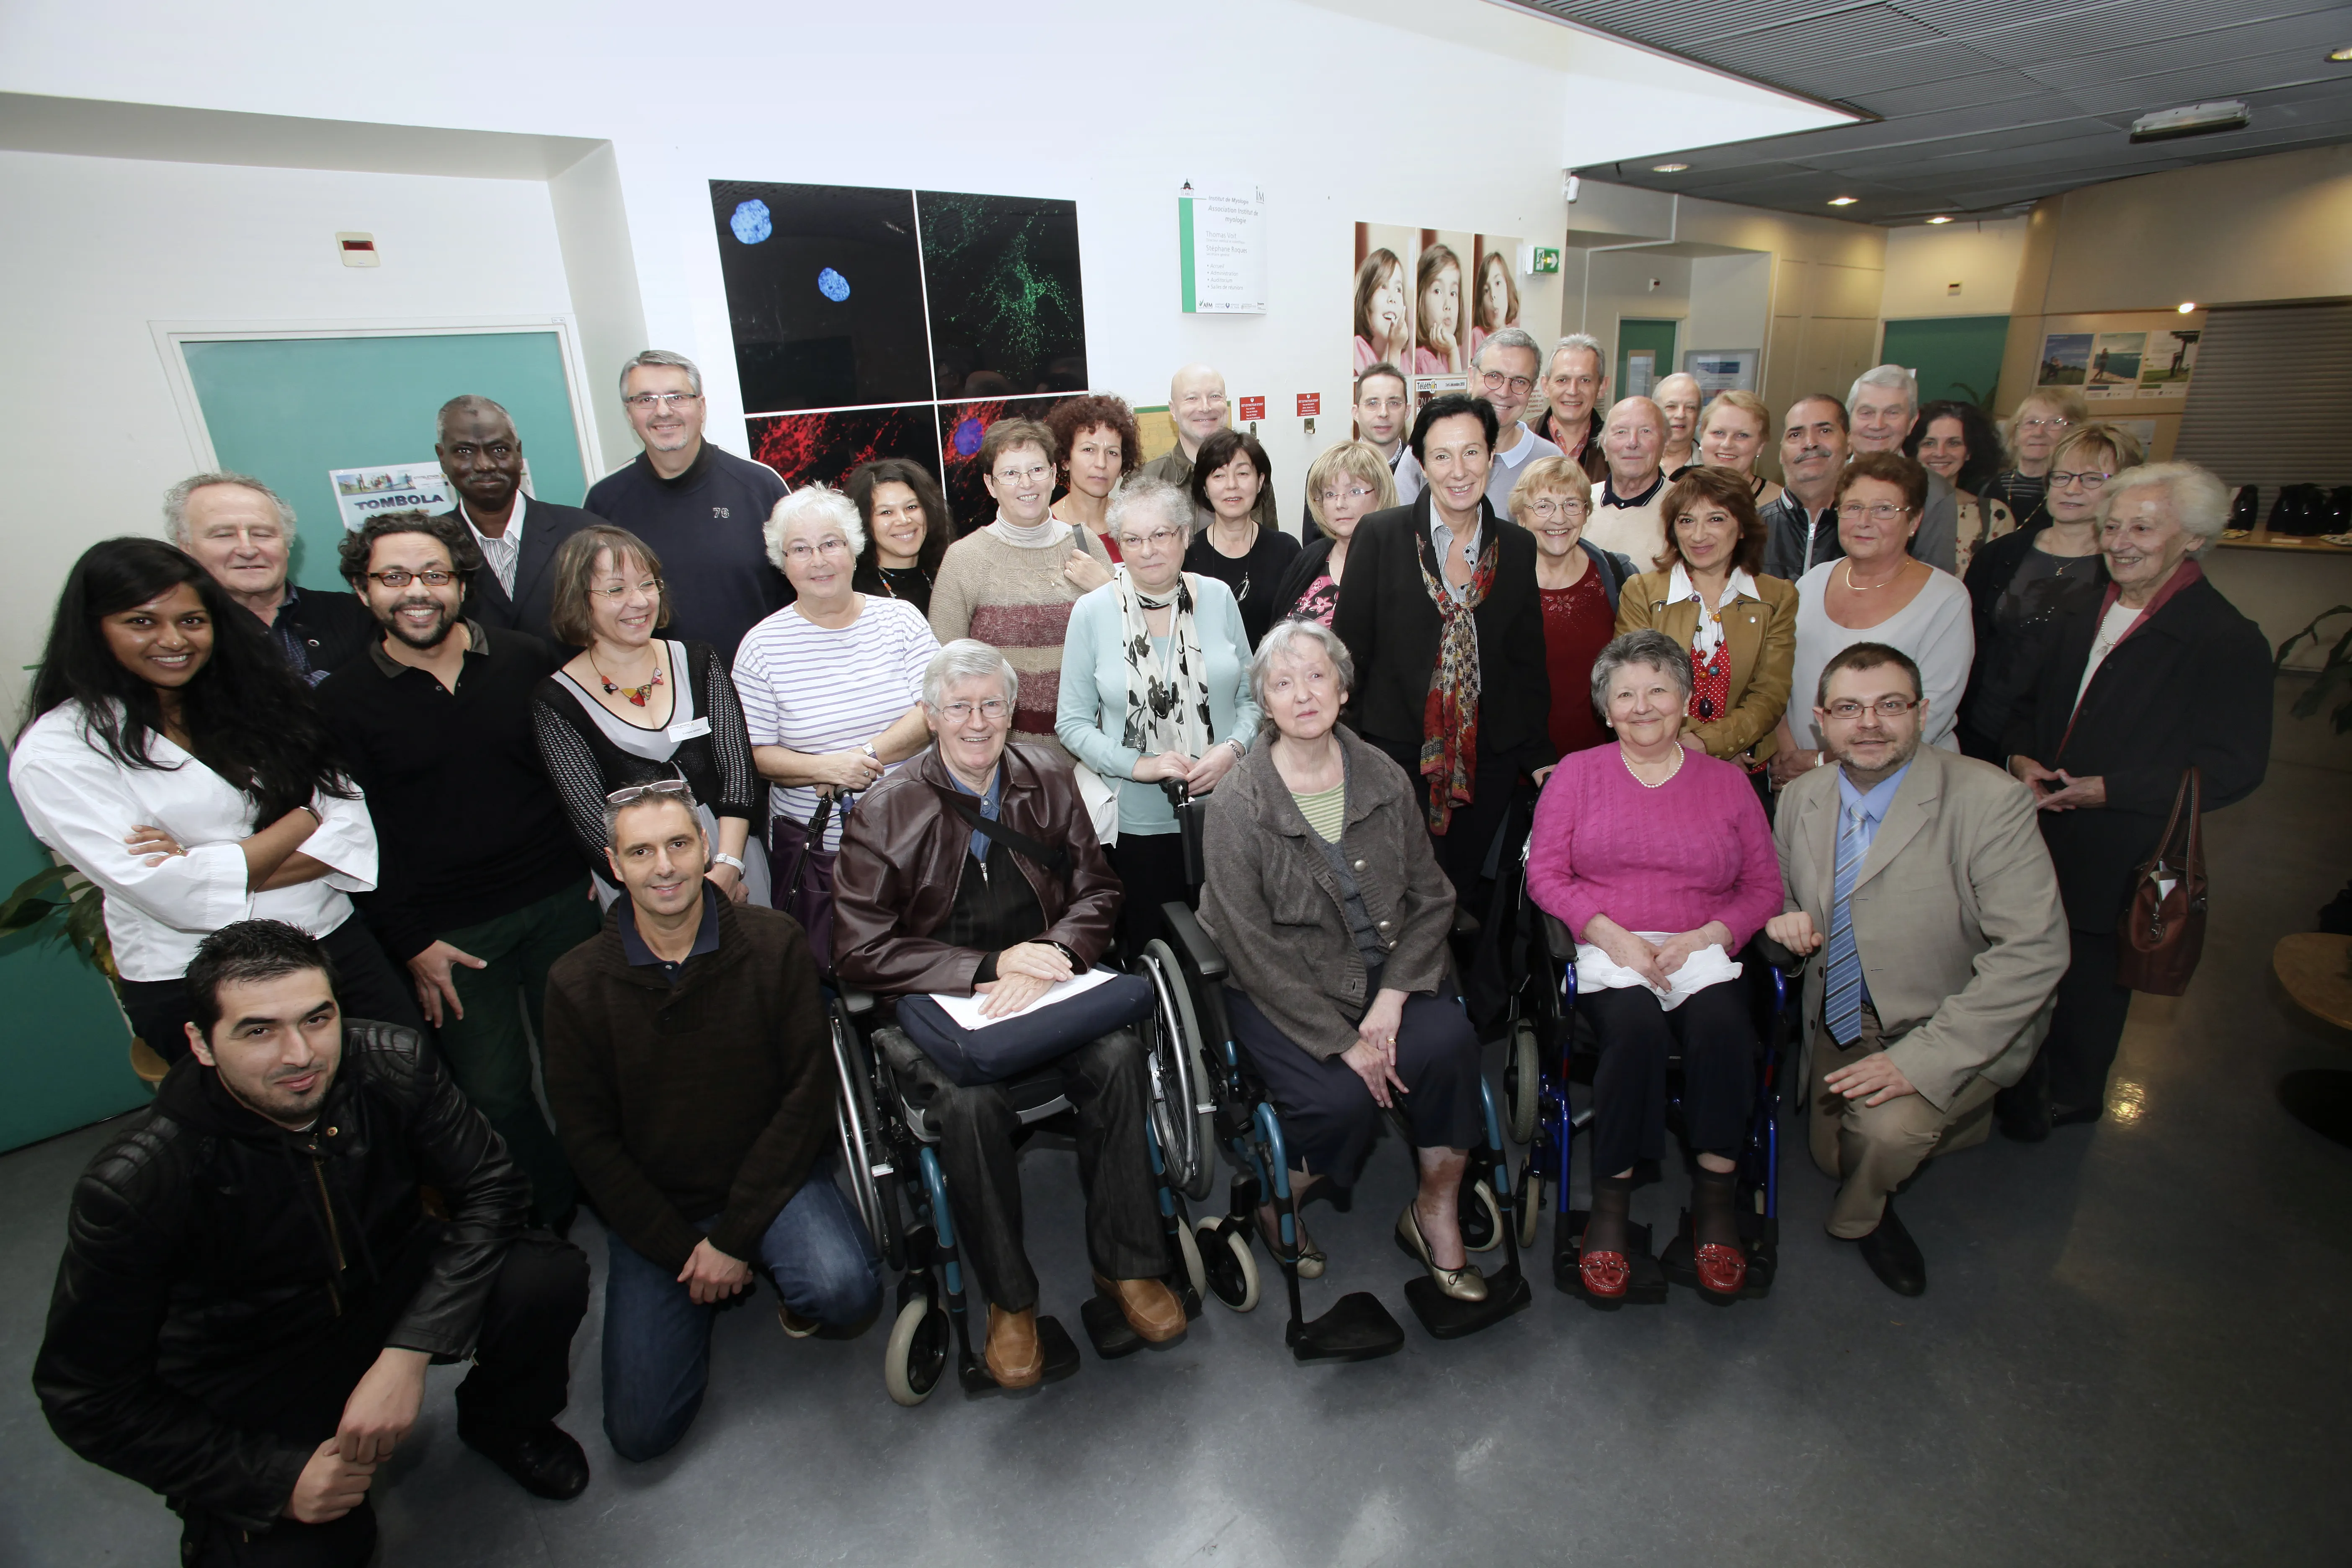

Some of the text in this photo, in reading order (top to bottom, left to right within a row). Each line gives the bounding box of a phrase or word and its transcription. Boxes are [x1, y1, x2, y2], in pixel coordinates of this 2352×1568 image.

[1208, 205, 1236, 214] Association
[1225, 216, 1246, 224] myologie
[354, 494, 444, 511] TOMBOLA
[713, 508, 729, 518] 76
